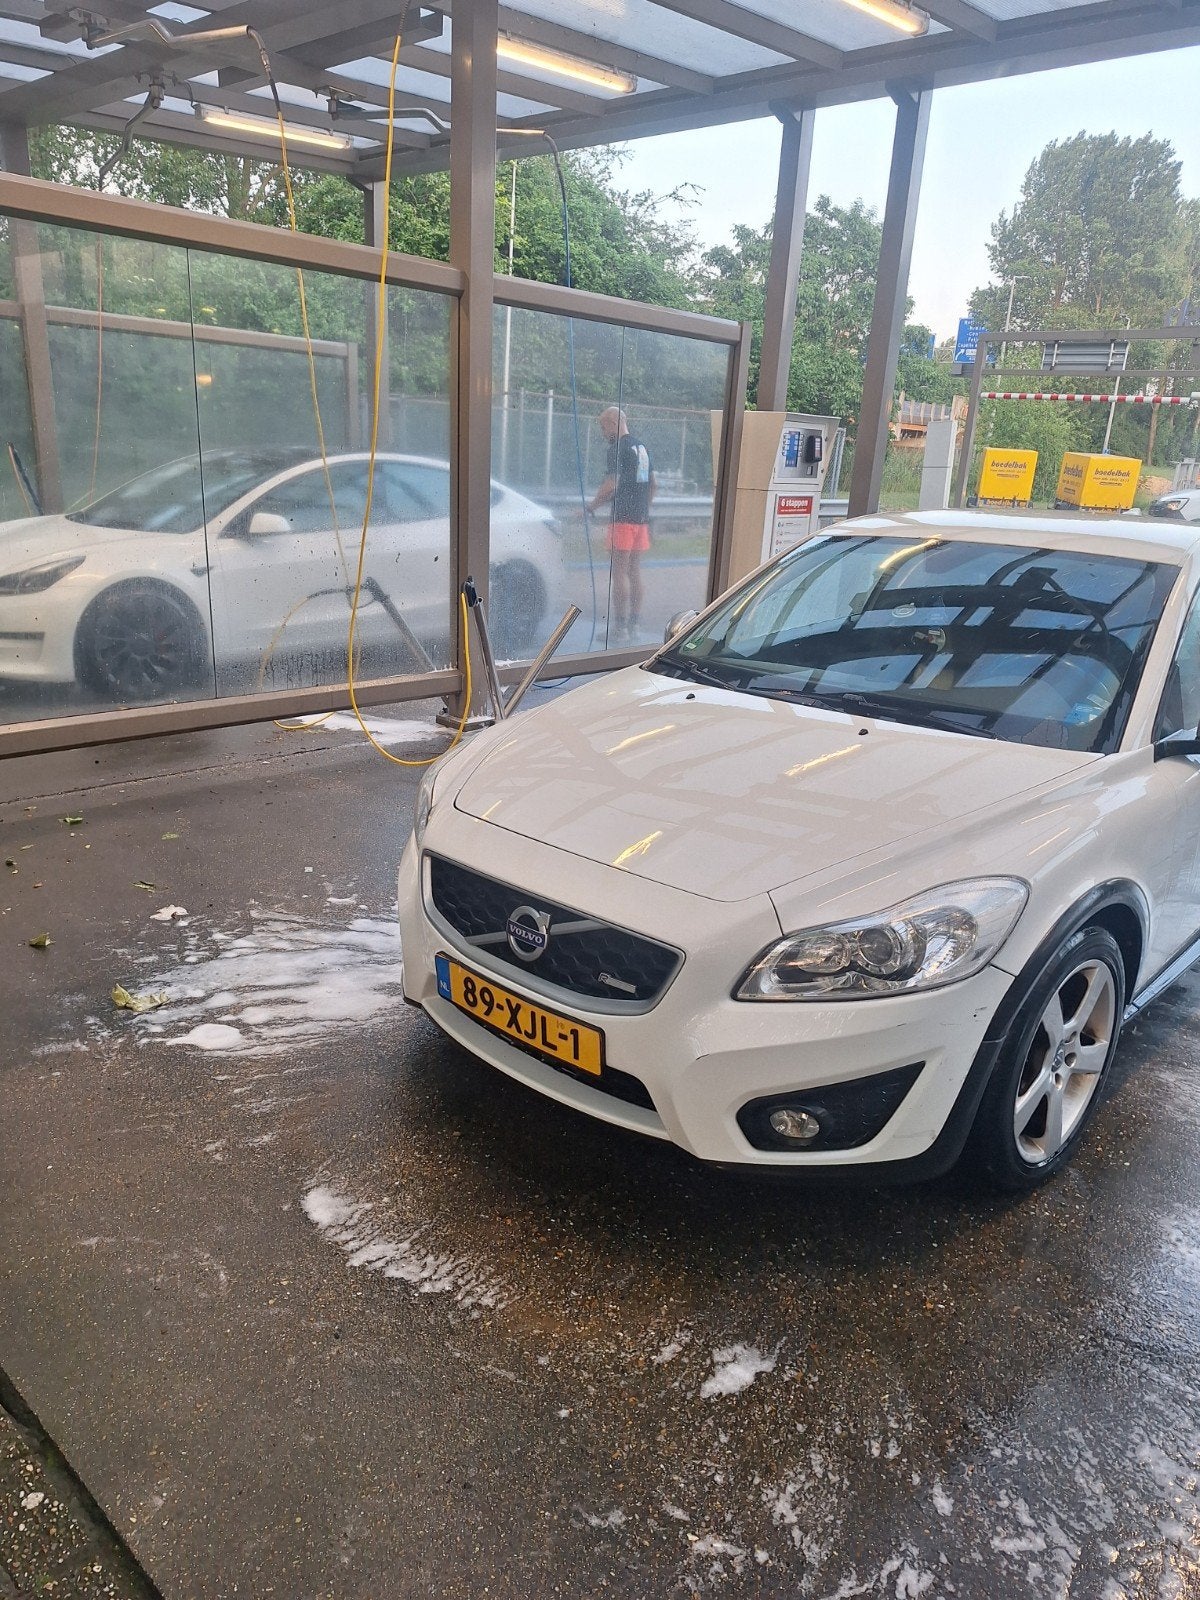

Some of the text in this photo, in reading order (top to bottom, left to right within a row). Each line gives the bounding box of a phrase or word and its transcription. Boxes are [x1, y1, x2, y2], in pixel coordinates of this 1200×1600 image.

[991, 460, 1027, 469] boedelbak
[1094, 468, 1131, 477] boedelbak
[781, 498, 808, 508] 6 stappen
[508, 924, 543, 945] VOLVO
[439, 980, 450, 991] NL
[463, 976, 580, 1061] 89-XJL-1
